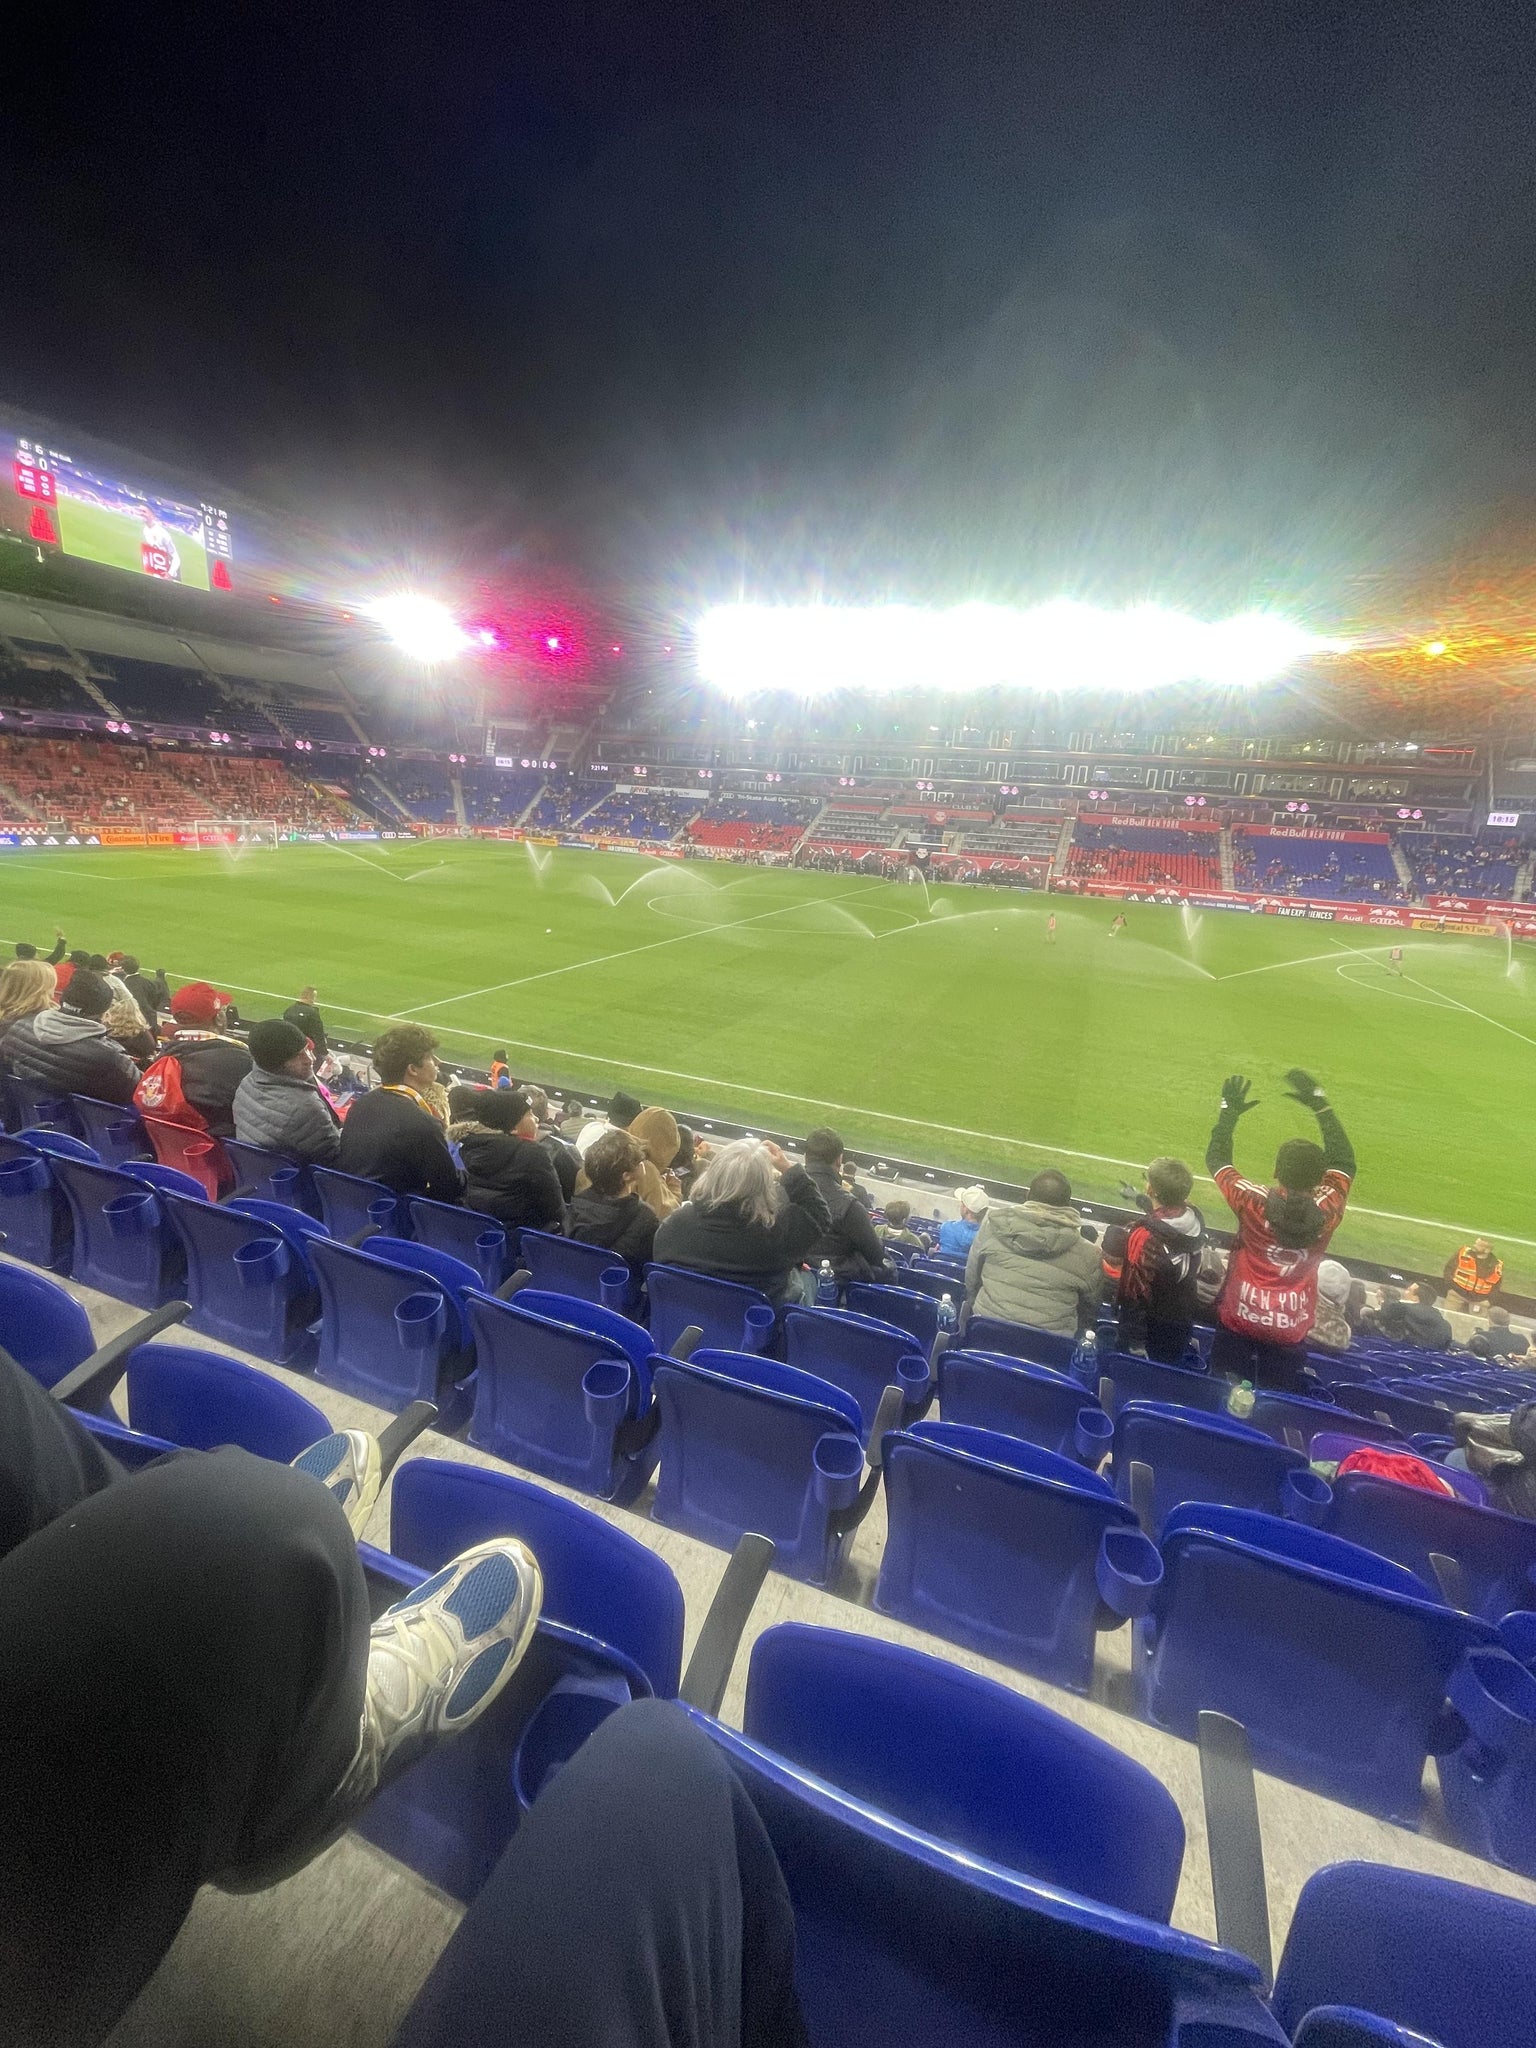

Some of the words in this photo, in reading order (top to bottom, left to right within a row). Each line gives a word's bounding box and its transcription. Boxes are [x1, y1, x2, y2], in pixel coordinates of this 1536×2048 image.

[1111, 816, 1128, 826] Red
[1129, 818, 1146, 827] Bull
[1269, 827, 1288, 837] Red
[1288, 829, 1308, 838] Bull
[1277, 907, 1291, 916] FAN
[1342, 914, 1364, 922] Audi
[1240, 1281, 1271, 1311] NEW
[1236, 1301, 1274, 1327] Red
